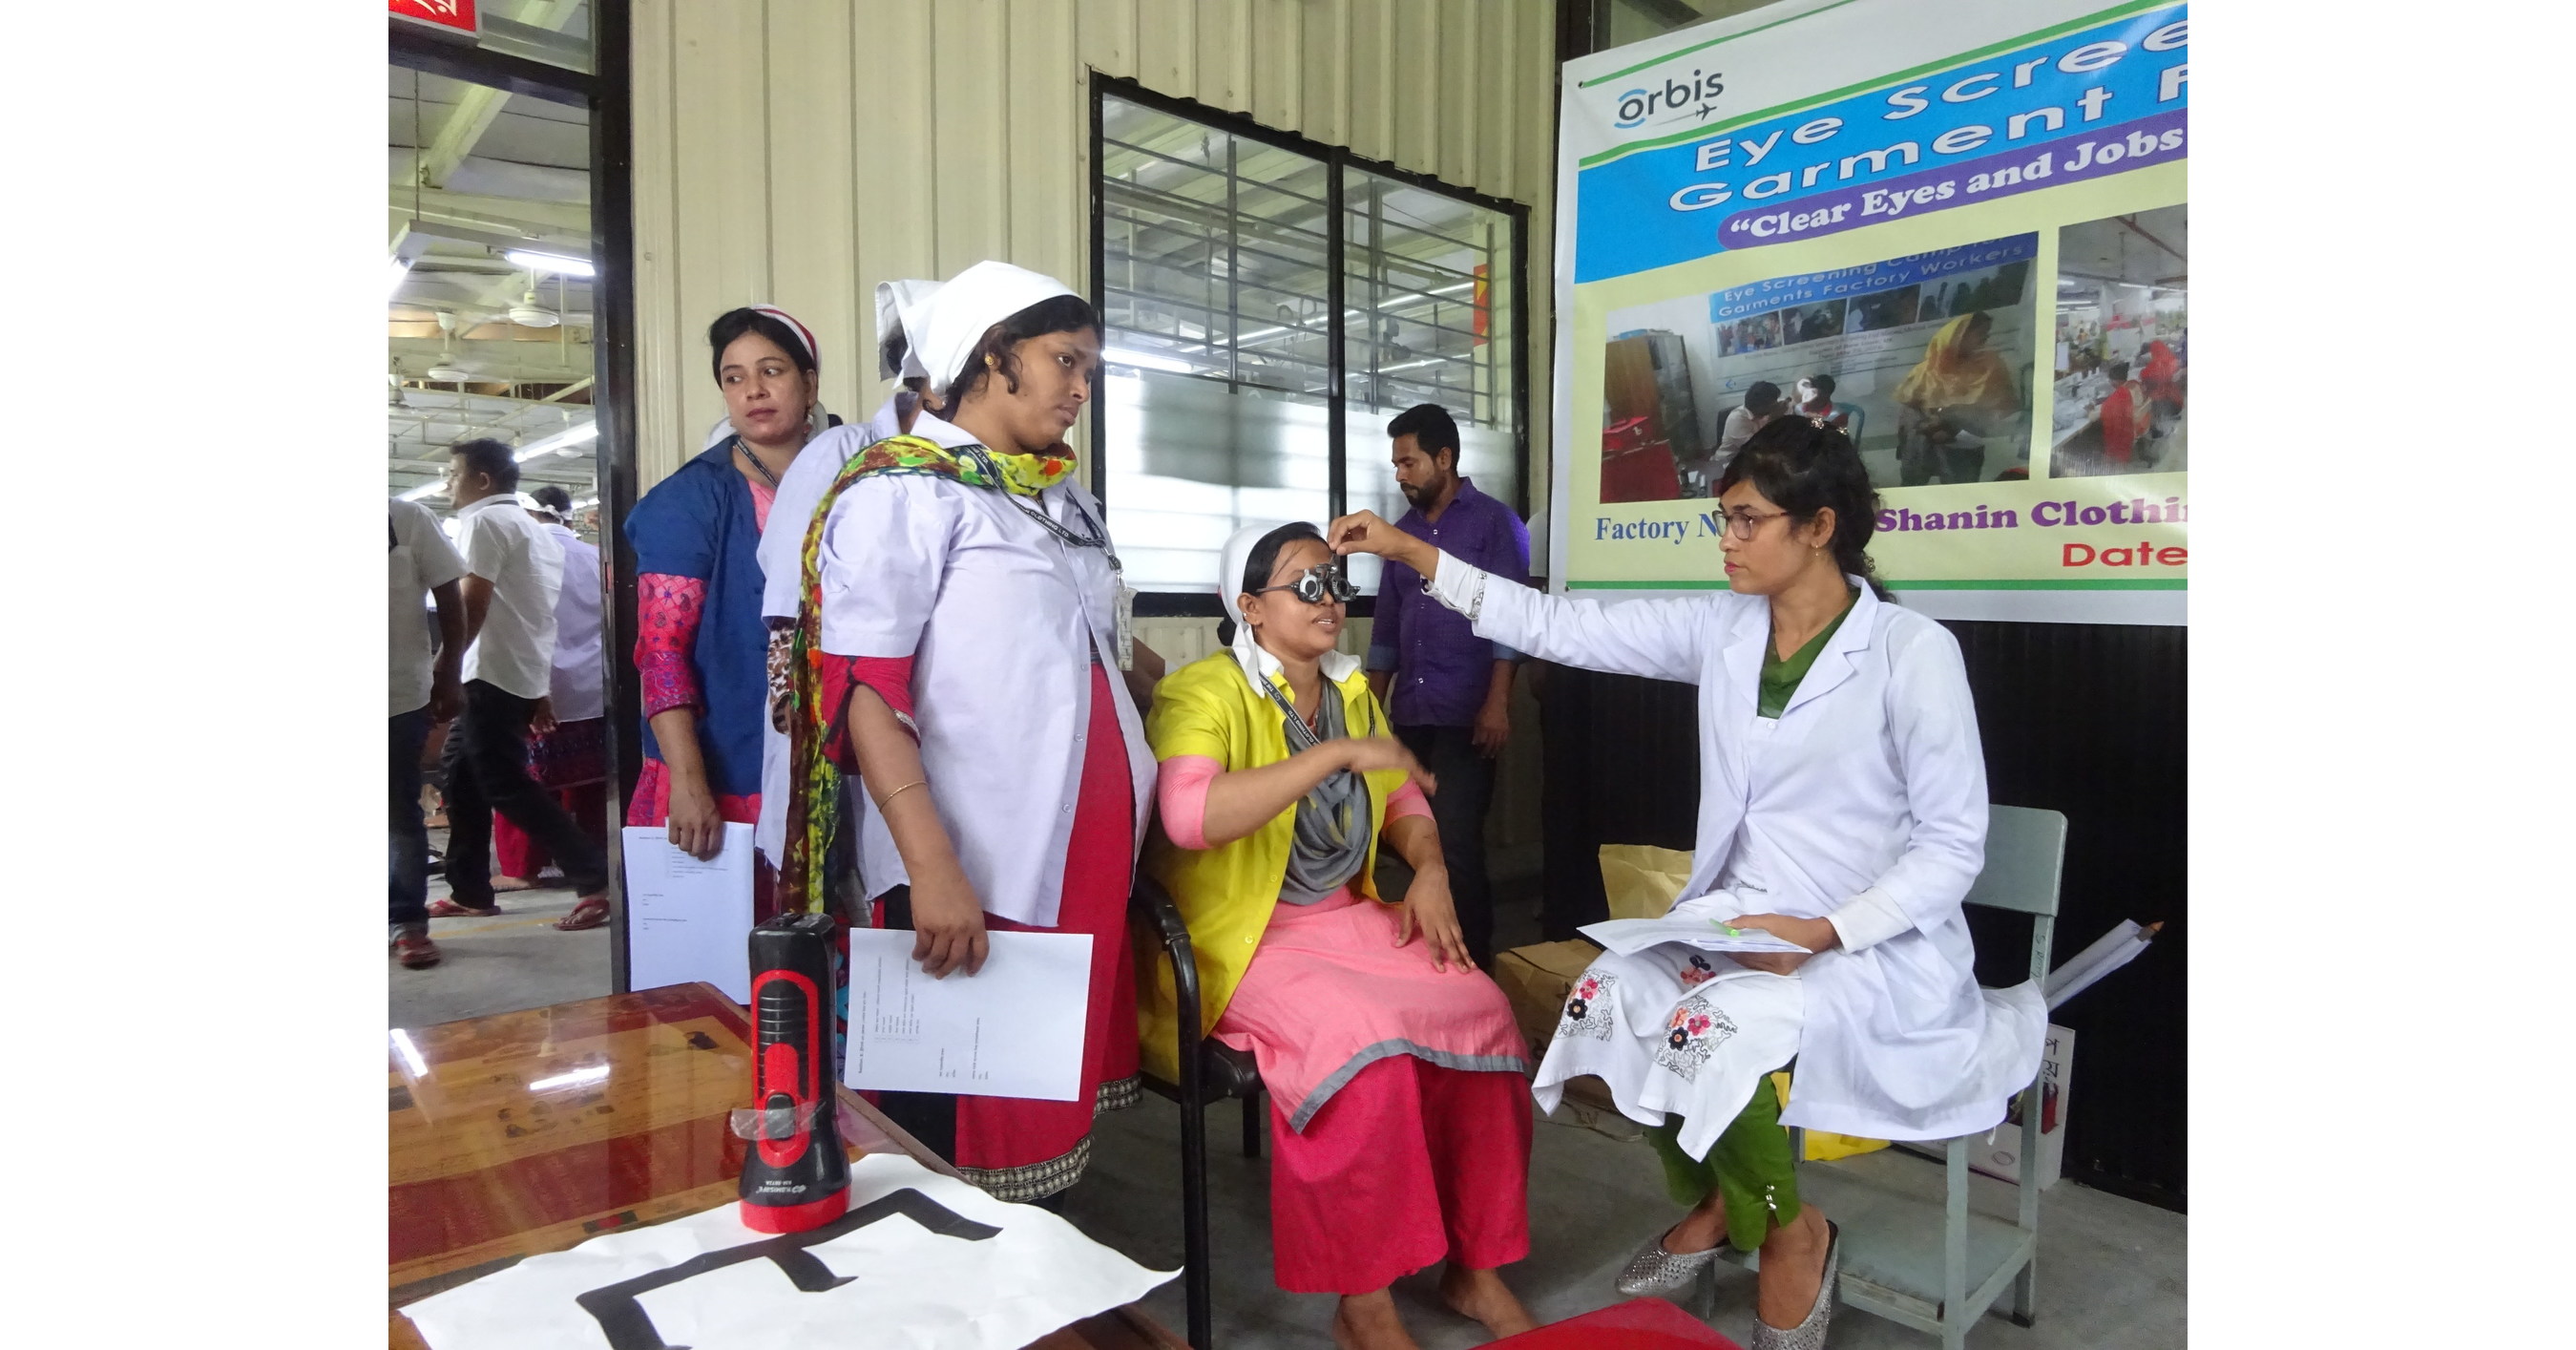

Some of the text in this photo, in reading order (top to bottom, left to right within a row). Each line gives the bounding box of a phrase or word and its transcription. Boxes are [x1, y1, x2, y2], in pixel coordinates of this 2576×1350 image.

[1618, 69, 1724, 121] orbis
[1668, 85, 2114, 212] Garment
[1695, 112, 1843, 172] Eye
[1861, 180, 1957, 217] Eyes
[1967, 153, 2053, 193] and
[2063, 128, 2184, 172] Jobs
[1719, 244, 2023, 317] Garments Factory Workers
[1724, 287, 1755, 302] Eye
[1762, 264, 1877, 292] Screening
[1031, 511, 1058, 531] CLOTHING
[1595, 517, 1689, 545] Factory
[1874, 504, 2019, 533] Shanin
[2031, 496, 2188, 527] Clothi
[2063, 541, 2188, 567] Date
[1296, 721, 1314, 743] CLOTHING
